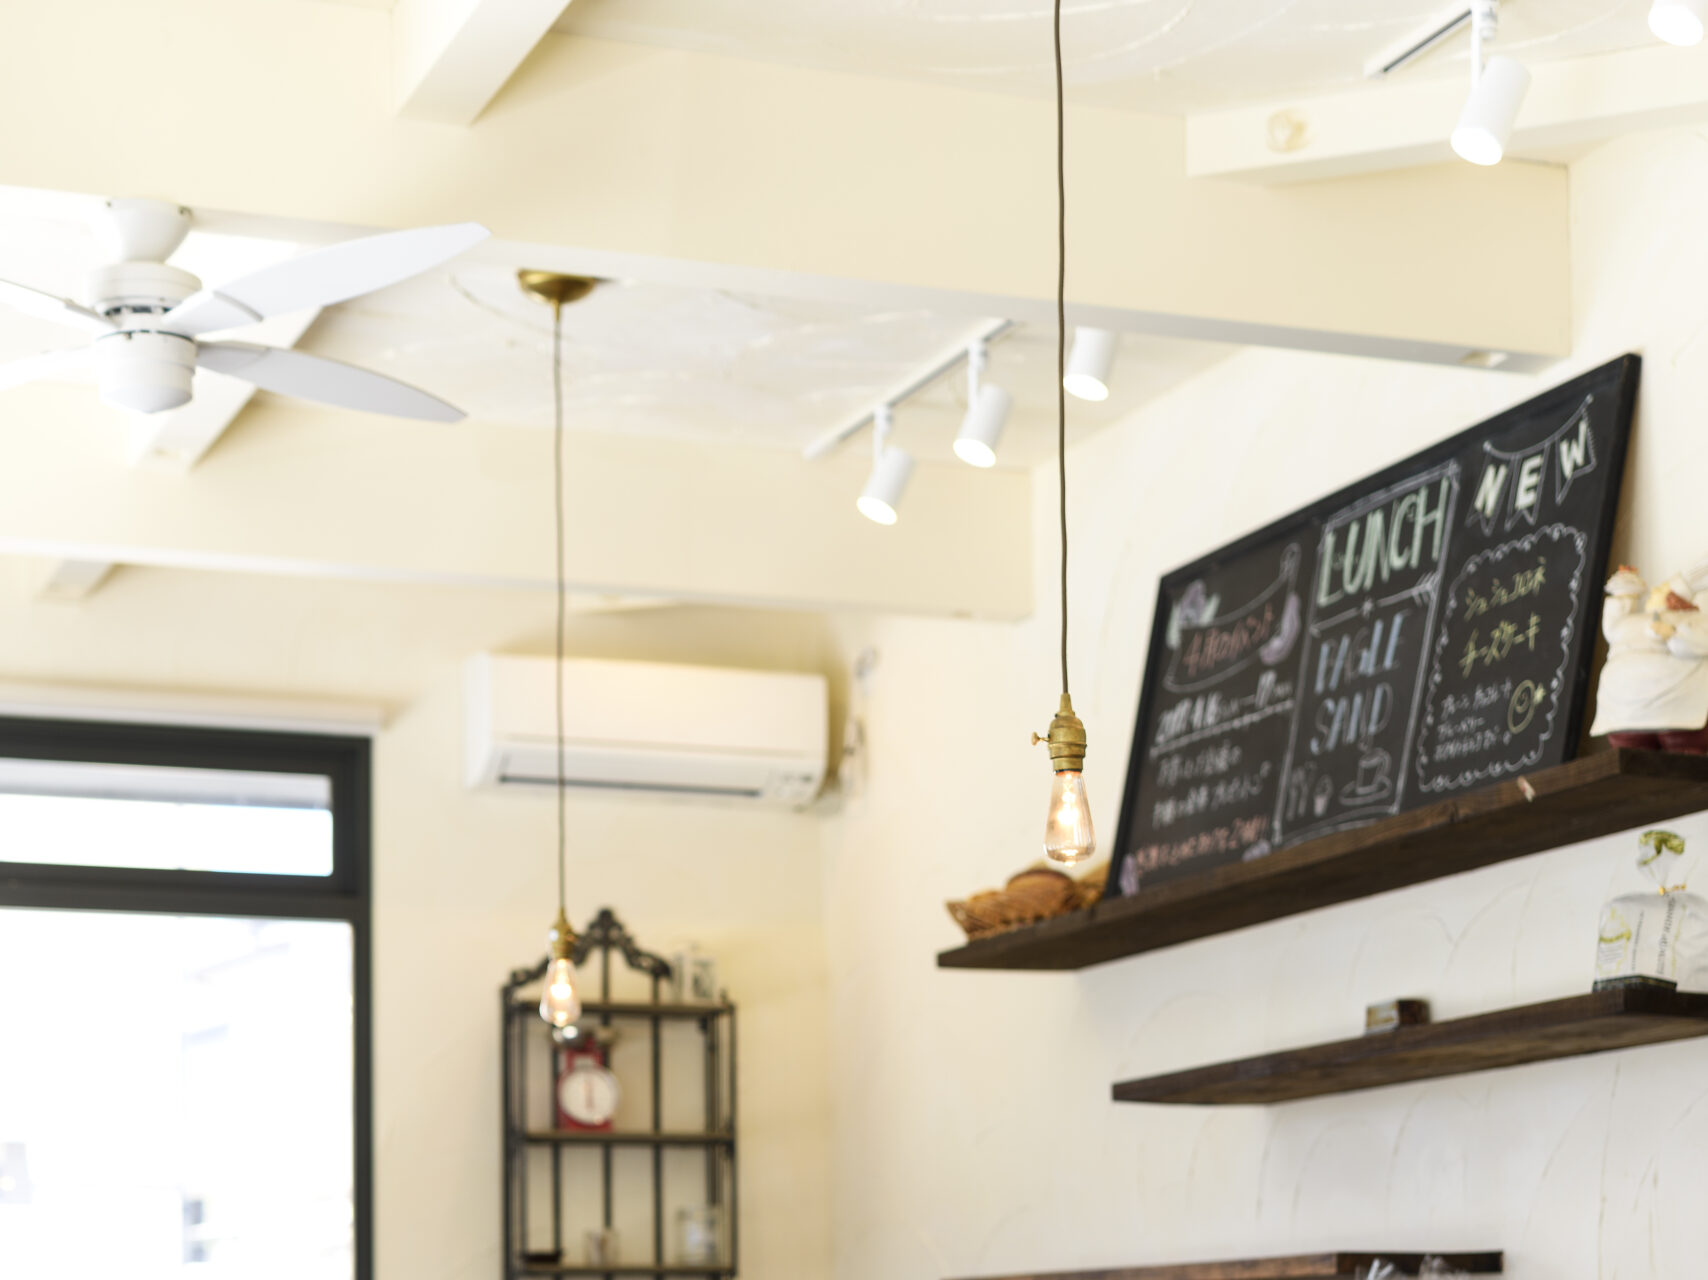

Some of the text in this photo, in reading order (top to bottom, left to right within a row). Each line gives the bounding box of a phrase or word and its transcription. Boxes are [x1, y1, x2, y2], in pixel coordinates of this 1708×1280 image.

[1474, 419, 1588, 518] NEW
[1317, 475, 1450, 608] LUNCH
[1310, 682, 1394, 756] SAND
